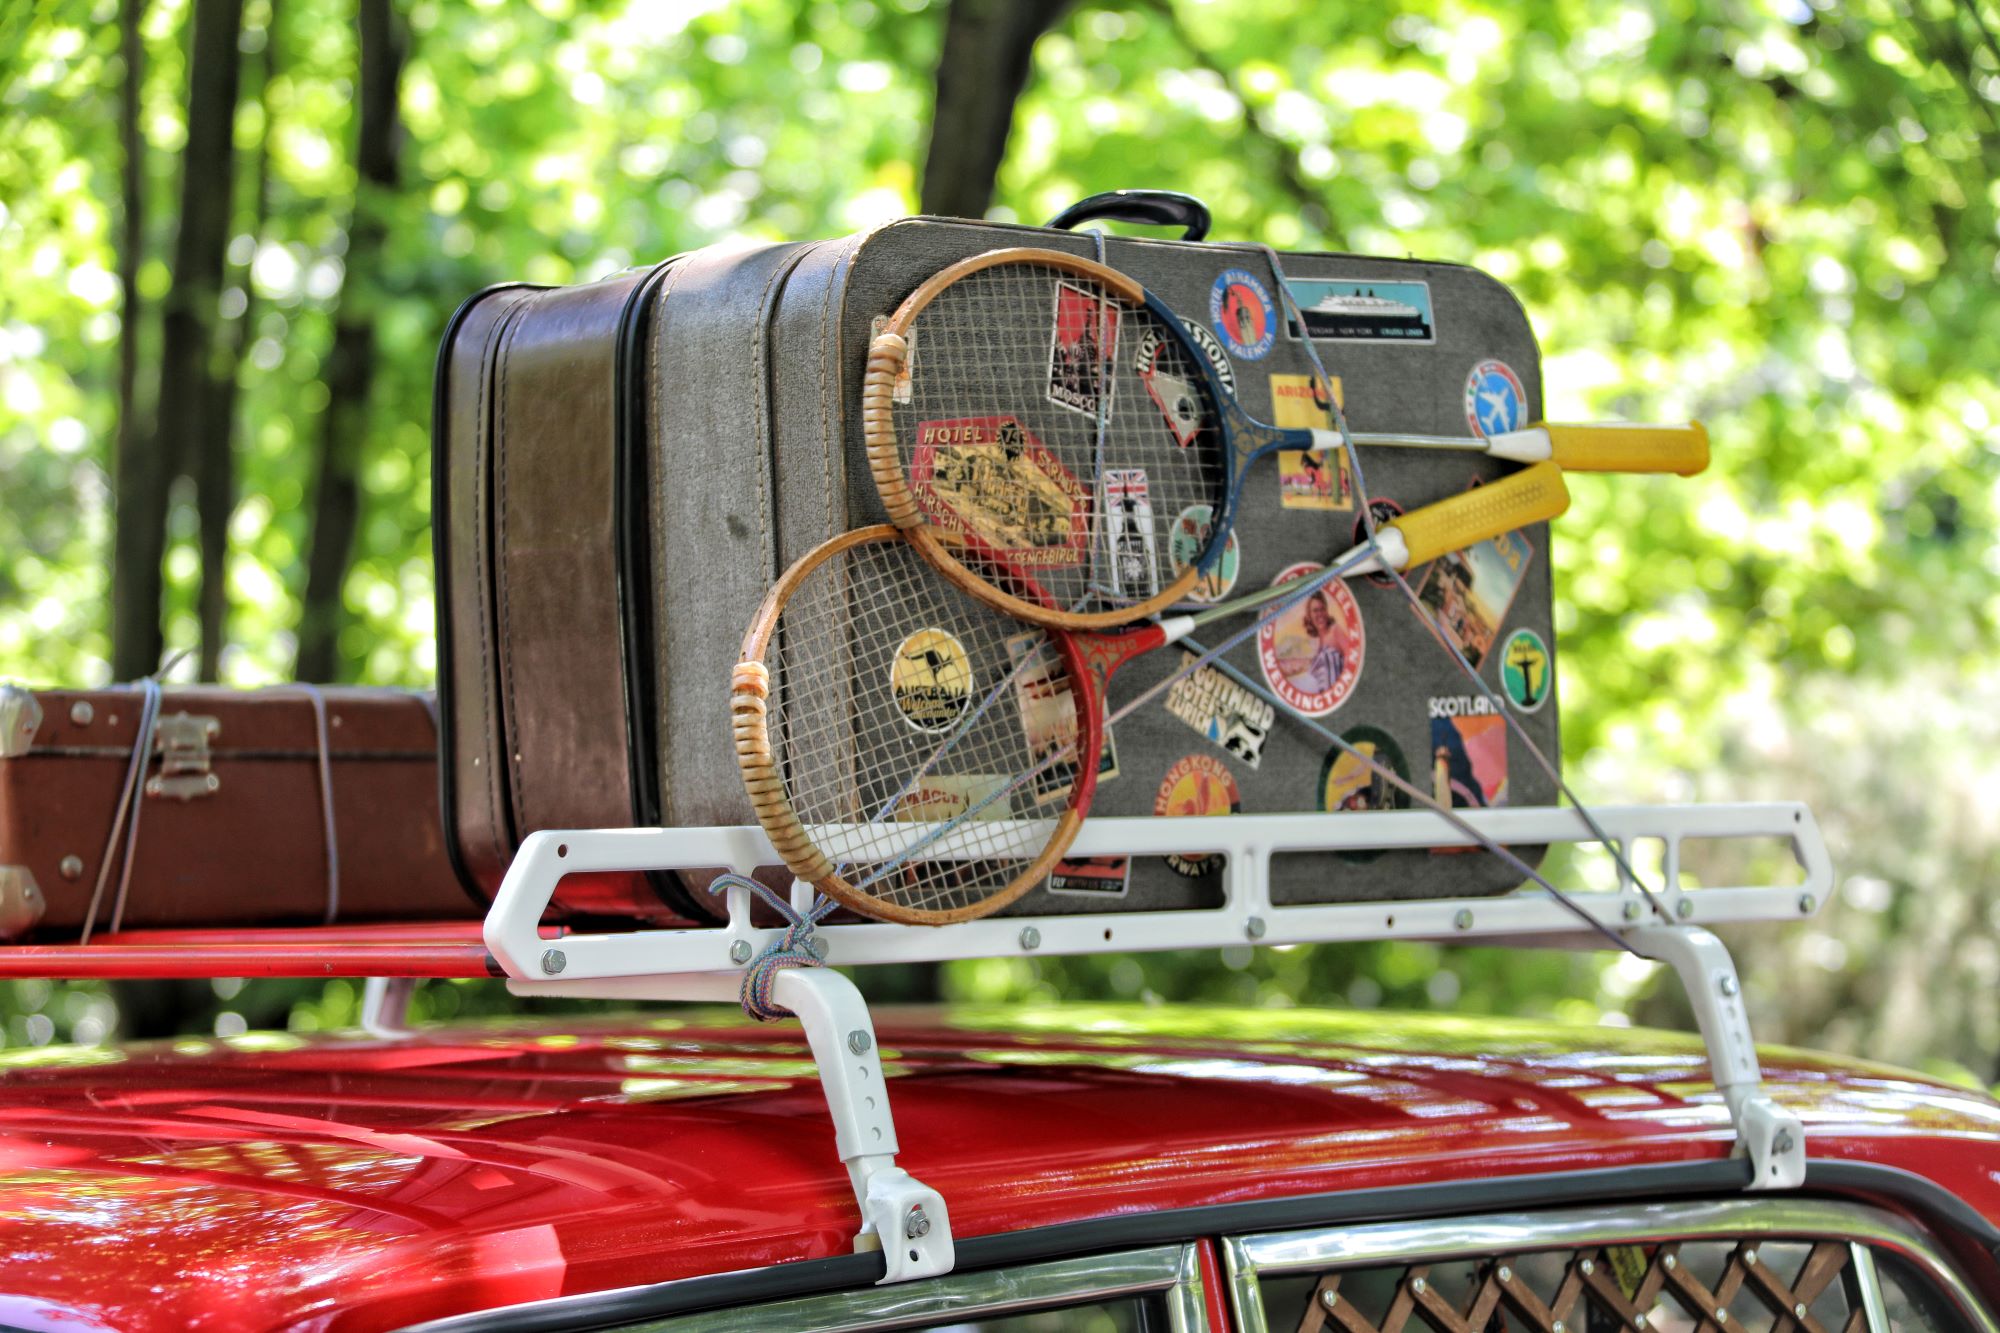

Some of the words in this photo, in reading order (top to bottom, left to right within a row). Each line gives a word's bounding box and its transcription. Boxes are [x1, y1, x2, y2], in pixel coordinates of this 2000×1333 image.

[1136, 330, 1160, 373] HOT
[1228, 331, 1275, 360] VALENCIA
[1052, 383, 1096, 411] MOSCO
[924, 425, 983, 445] HOTEL
[895, 683, 966, 699] AUSTRALIA
[1264, 648, 1353, 711] WELLINGTON
[1155, 756, 1230, 813] HONGKONG
